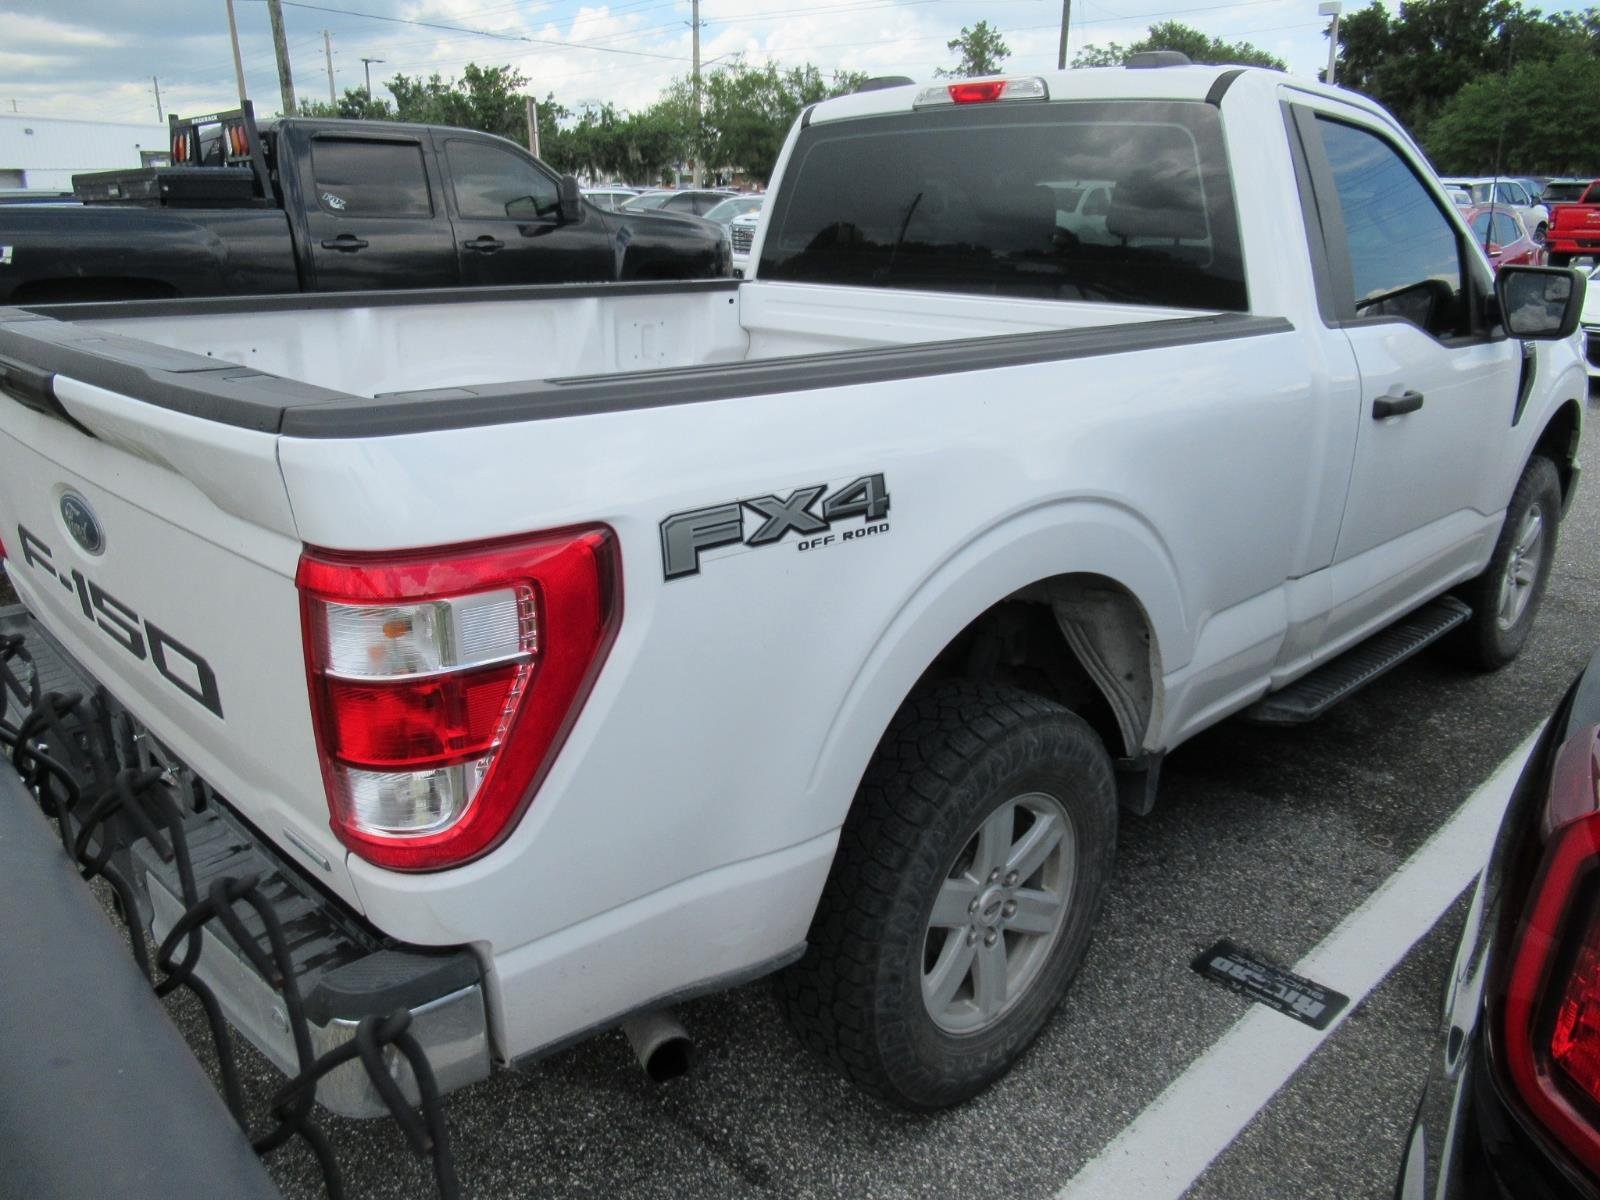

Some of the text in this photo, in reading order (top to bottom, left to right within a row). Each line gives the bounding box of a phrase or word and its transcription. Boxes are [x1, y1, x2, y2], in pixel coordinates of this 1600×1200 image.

[659, 472, 890, 582] FX4
[798, 523, 890, 552] OFF ROAD
[18, 523, 224, 720] F-150
[1227, 952, 1267, 973] GMC
[1274, 974, 1325, 1000] BUICK
